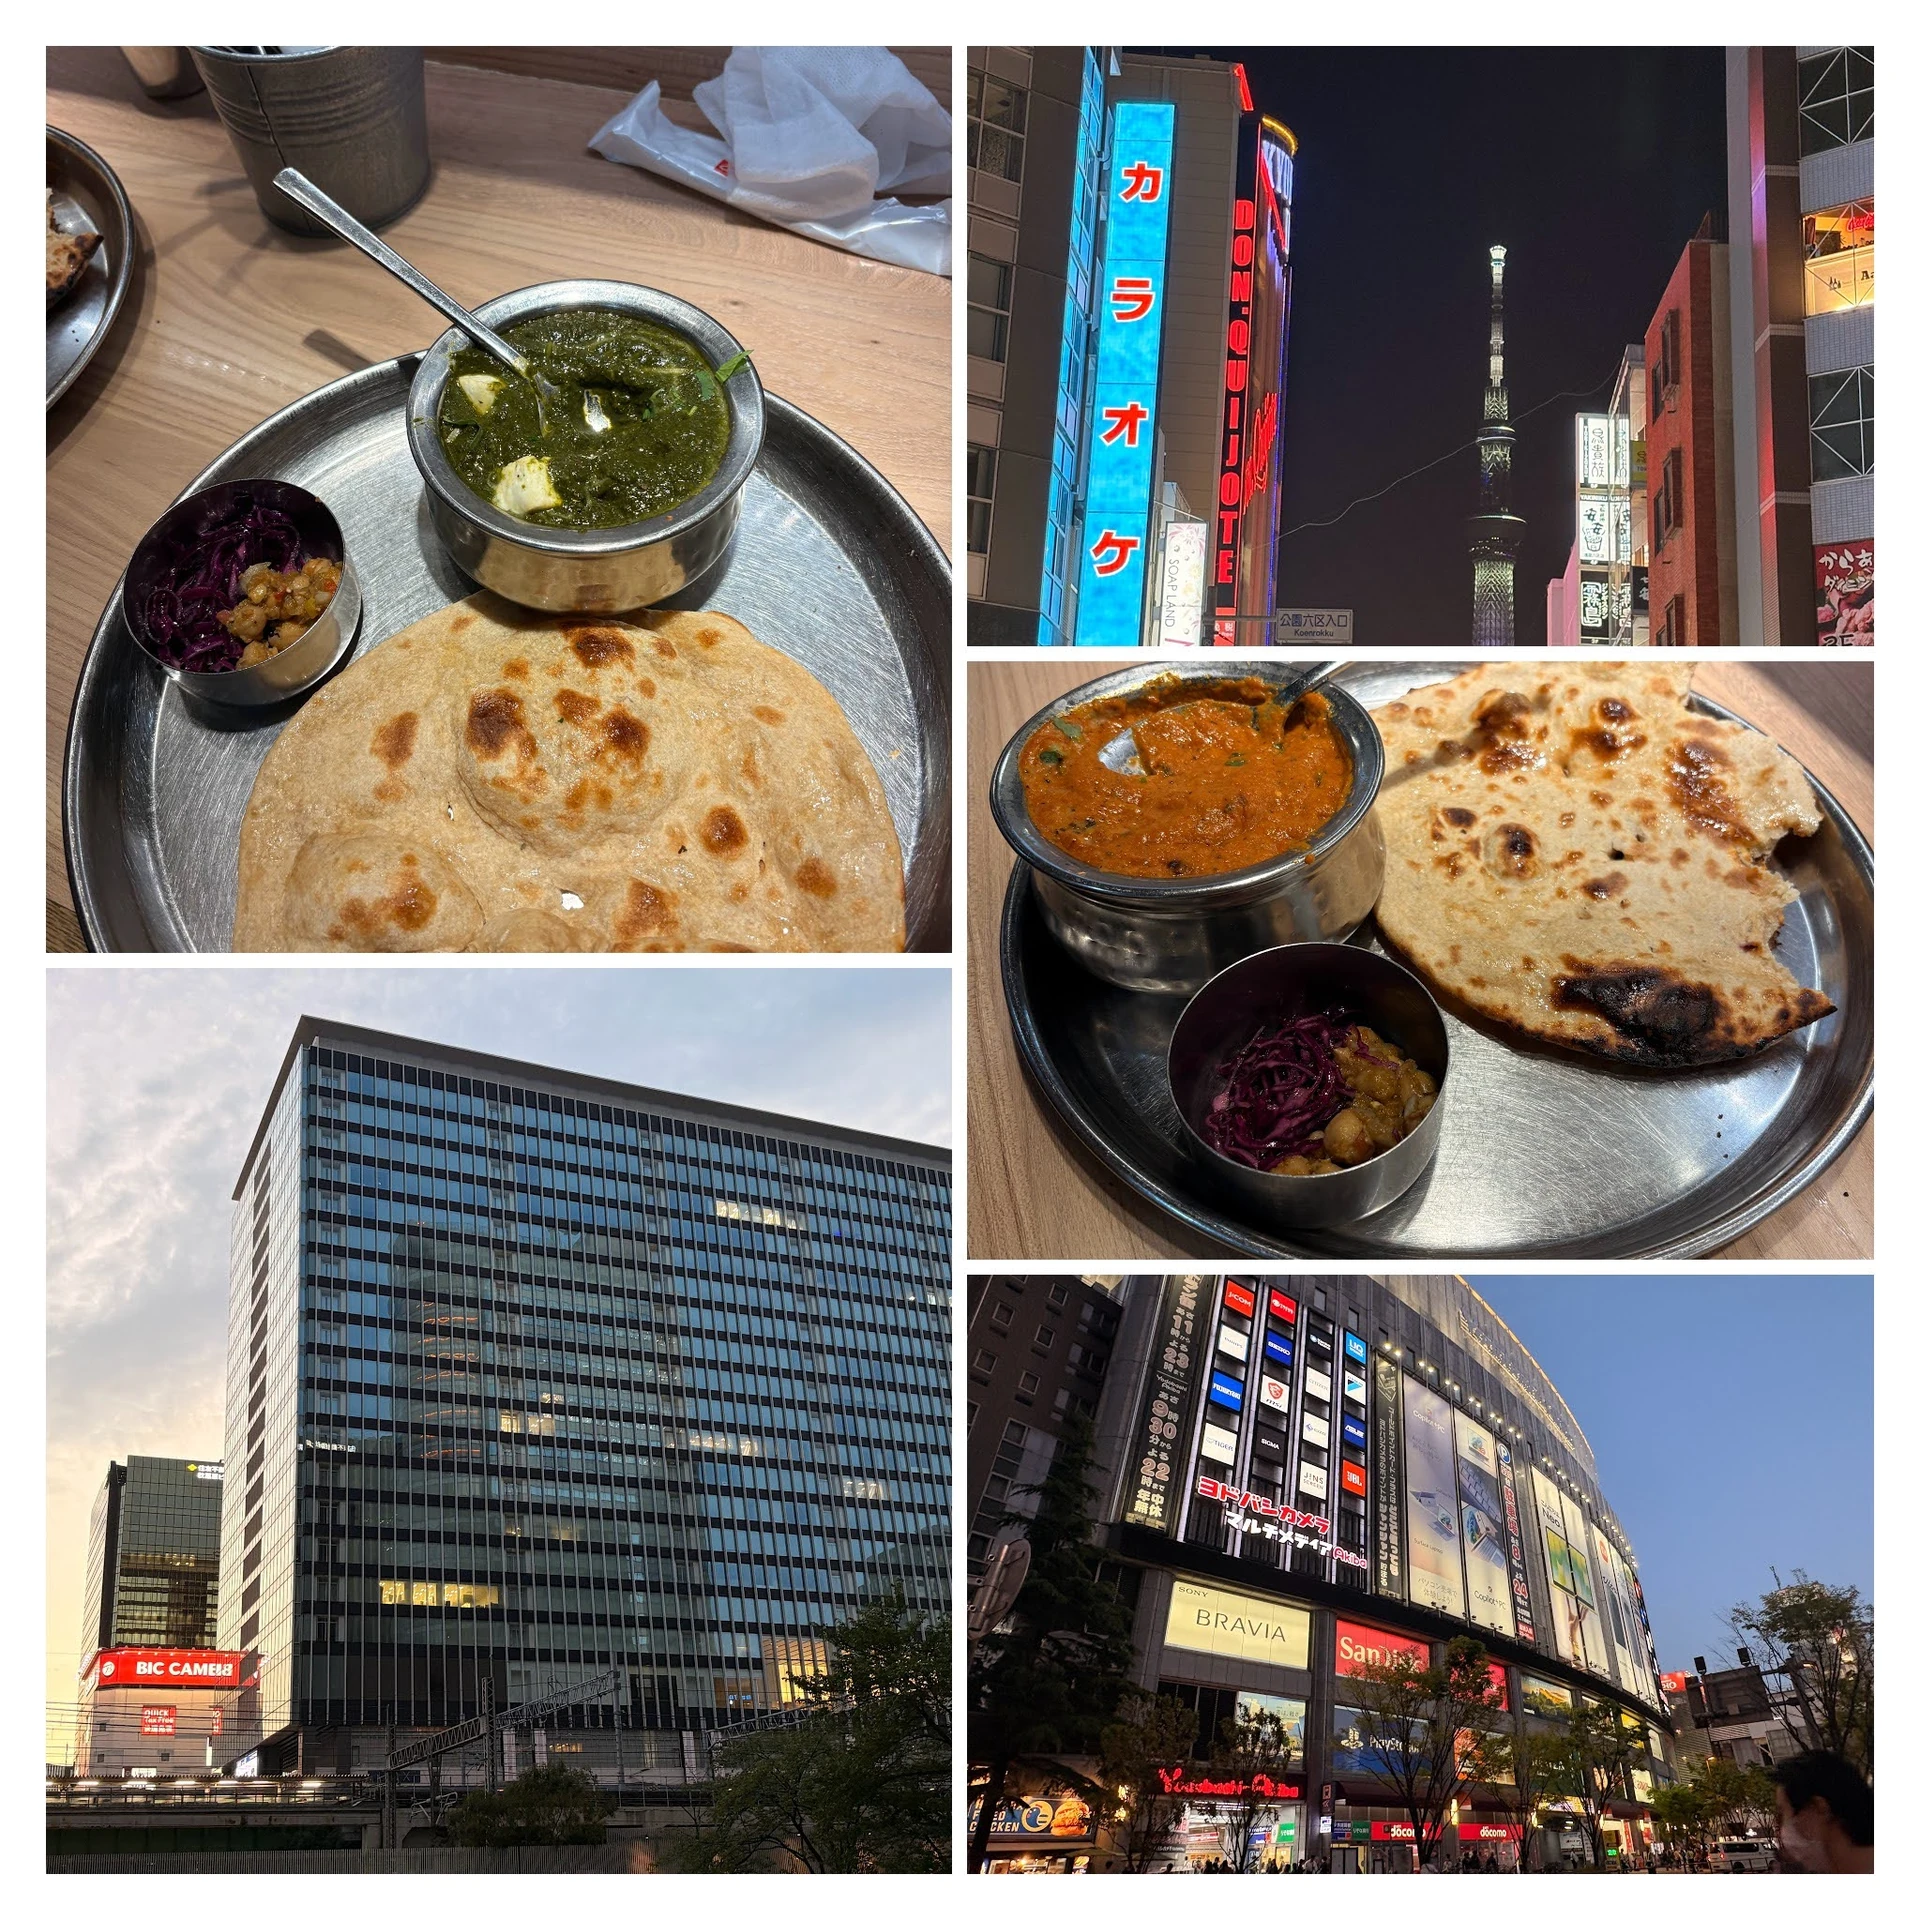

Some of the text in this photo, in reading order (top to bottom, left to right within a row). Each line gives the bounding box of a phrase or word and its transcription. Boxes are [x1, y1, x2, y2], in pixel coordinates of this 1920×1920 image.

[1090, 161, 1163, 577] カラオケ
[1164, 558, 1180, 628] SOAP LAND
[1280, 613, 1348, 627] 公園六区入口
[1293, 629, 1335, 637] Koenrokku
[1172, 1314, 1194, 1335] 11
[1163, 1346, 1190, 1369] 23
[1148, 1416, 1177, 1439] 30
[1148, 1434, 1172, 1450] 分から
[1214, 1440, 1234, 1452] TIGER
[1261, 1438, 1280, 1450] SIGMA
[1147, 1448, 1169, 1461] よる
[1140, 1457, 1171, 1482] 22
[1140, 1475, 1165, 1492] 時まで
[1197, 1475, 1331, 1535] ヨドバシカメラ
[1225, 1510, 1368, 1570] マルチメディア Akiba
[1511, 1544, 1521, 1561] 8
[1178, 1586, 1209, 1598] SONY
[1512, 1578, 1528, 1600] 24
[1196, 1608, 1286, 1642] BRAVIA
[136, 1661, 165, 1676] BIC
[972, 1810, 1006, 1821] FED
[969, 1822, 1020, 1832] CCKEN
[1480, 1825, 1507, 1838] docomo
